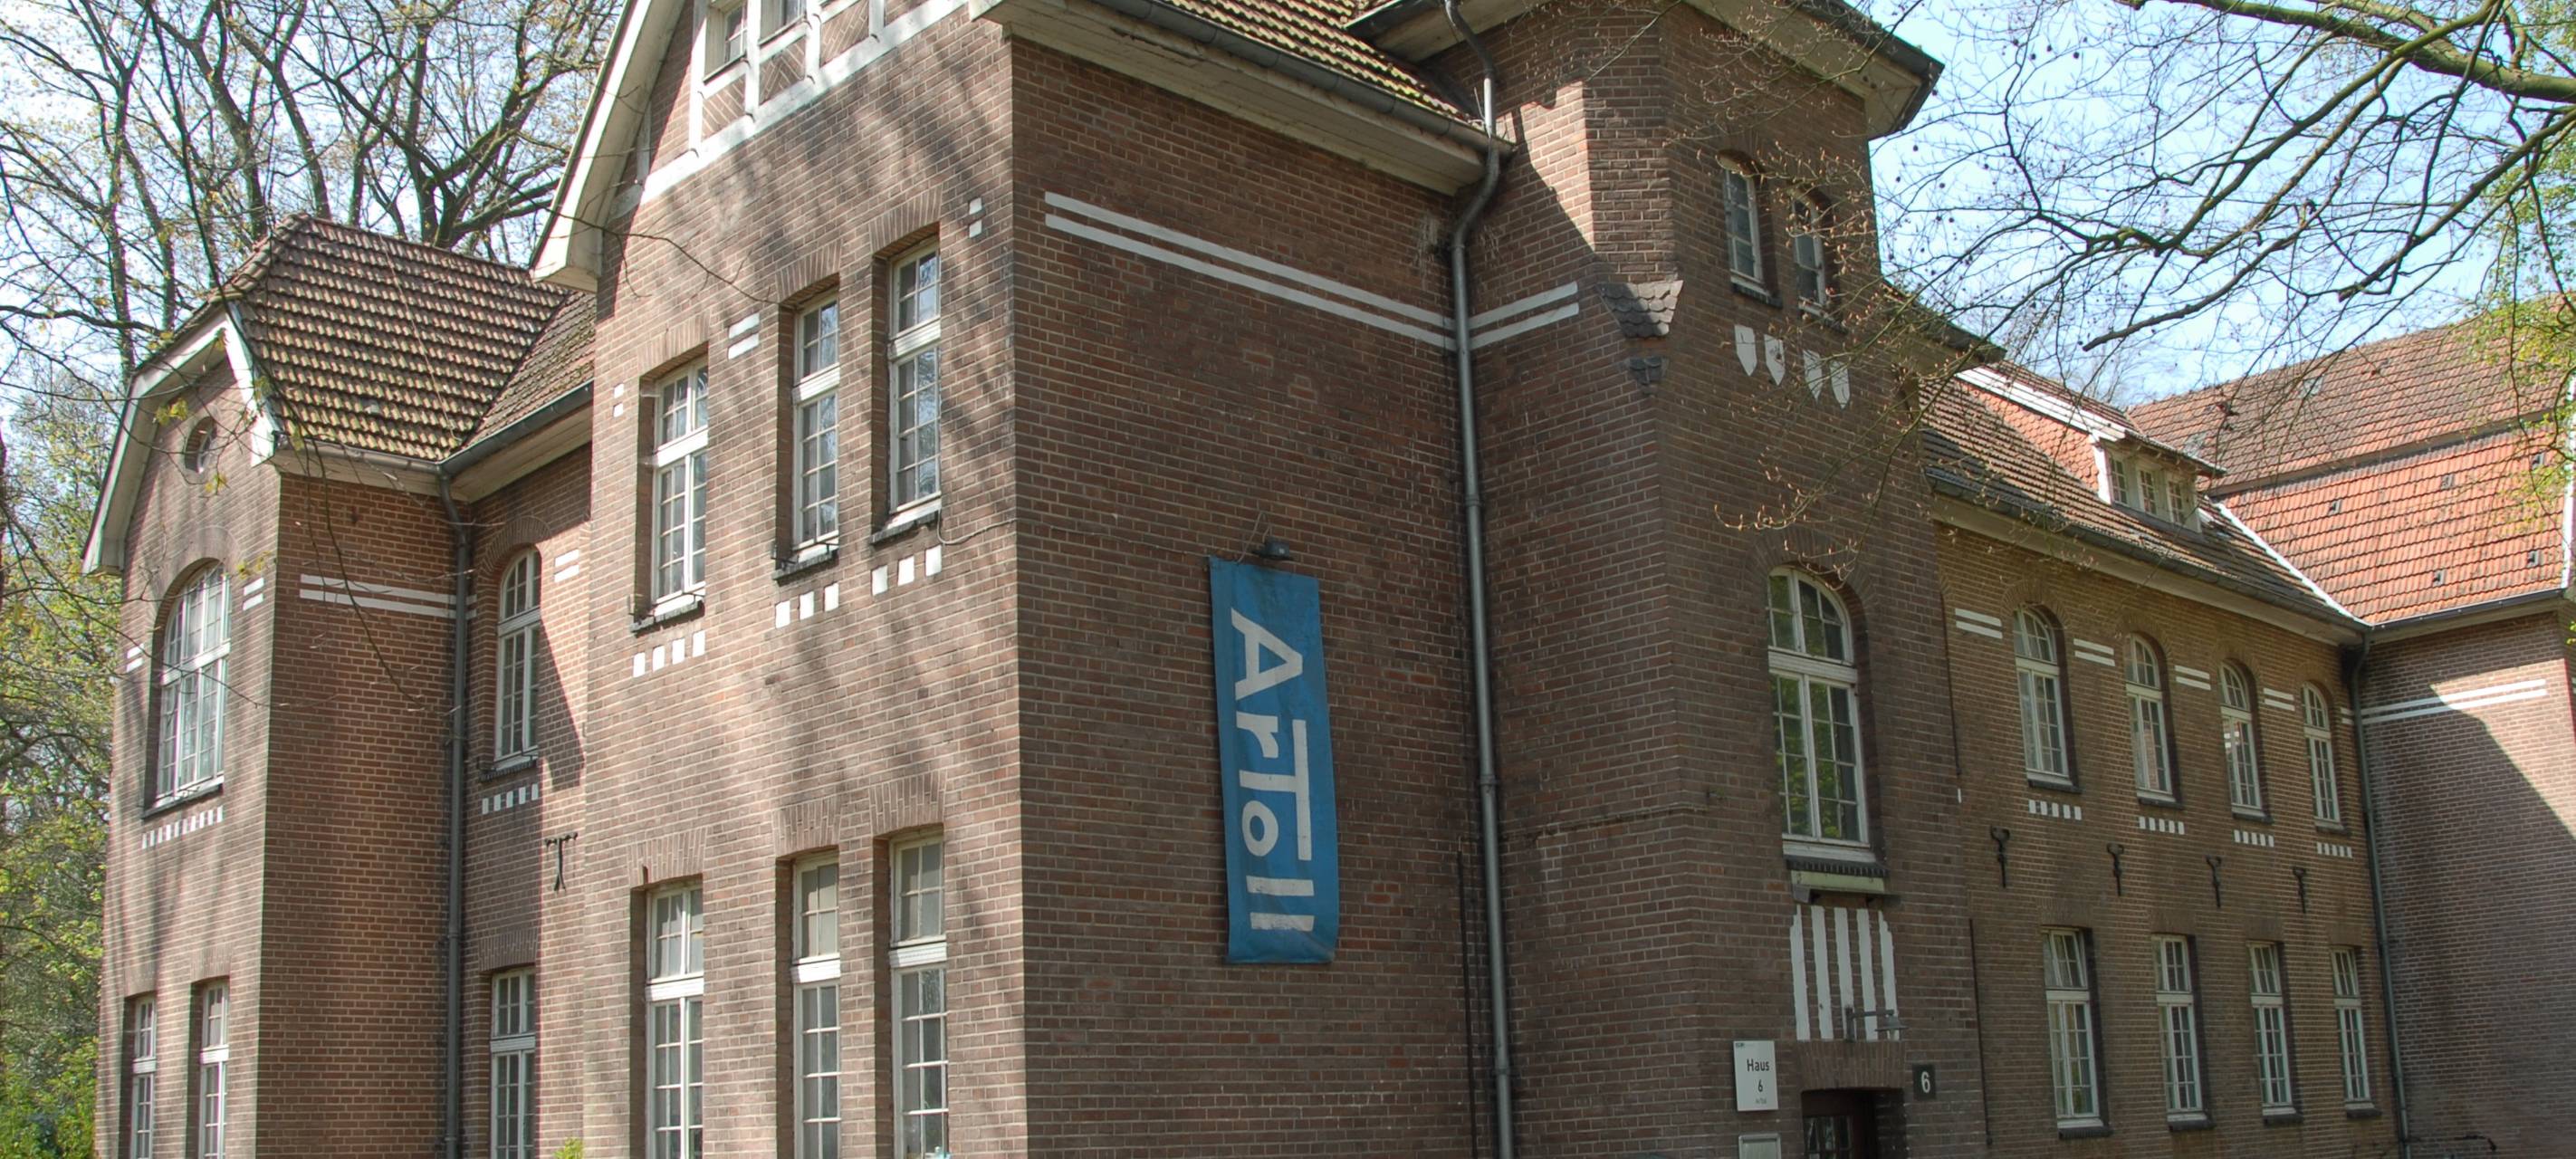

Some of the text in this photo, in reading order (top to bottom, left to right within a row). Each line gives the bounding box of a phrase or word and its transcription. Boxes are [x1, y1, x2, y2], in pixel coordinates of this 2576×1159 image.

[1231, 607, 1314, 932] ArToll
[1747, 1058, 1769, 1072] Haus
[1757, 1078, 1764, 1092] 6
[1921, 1070, 1930, 1093] 6
